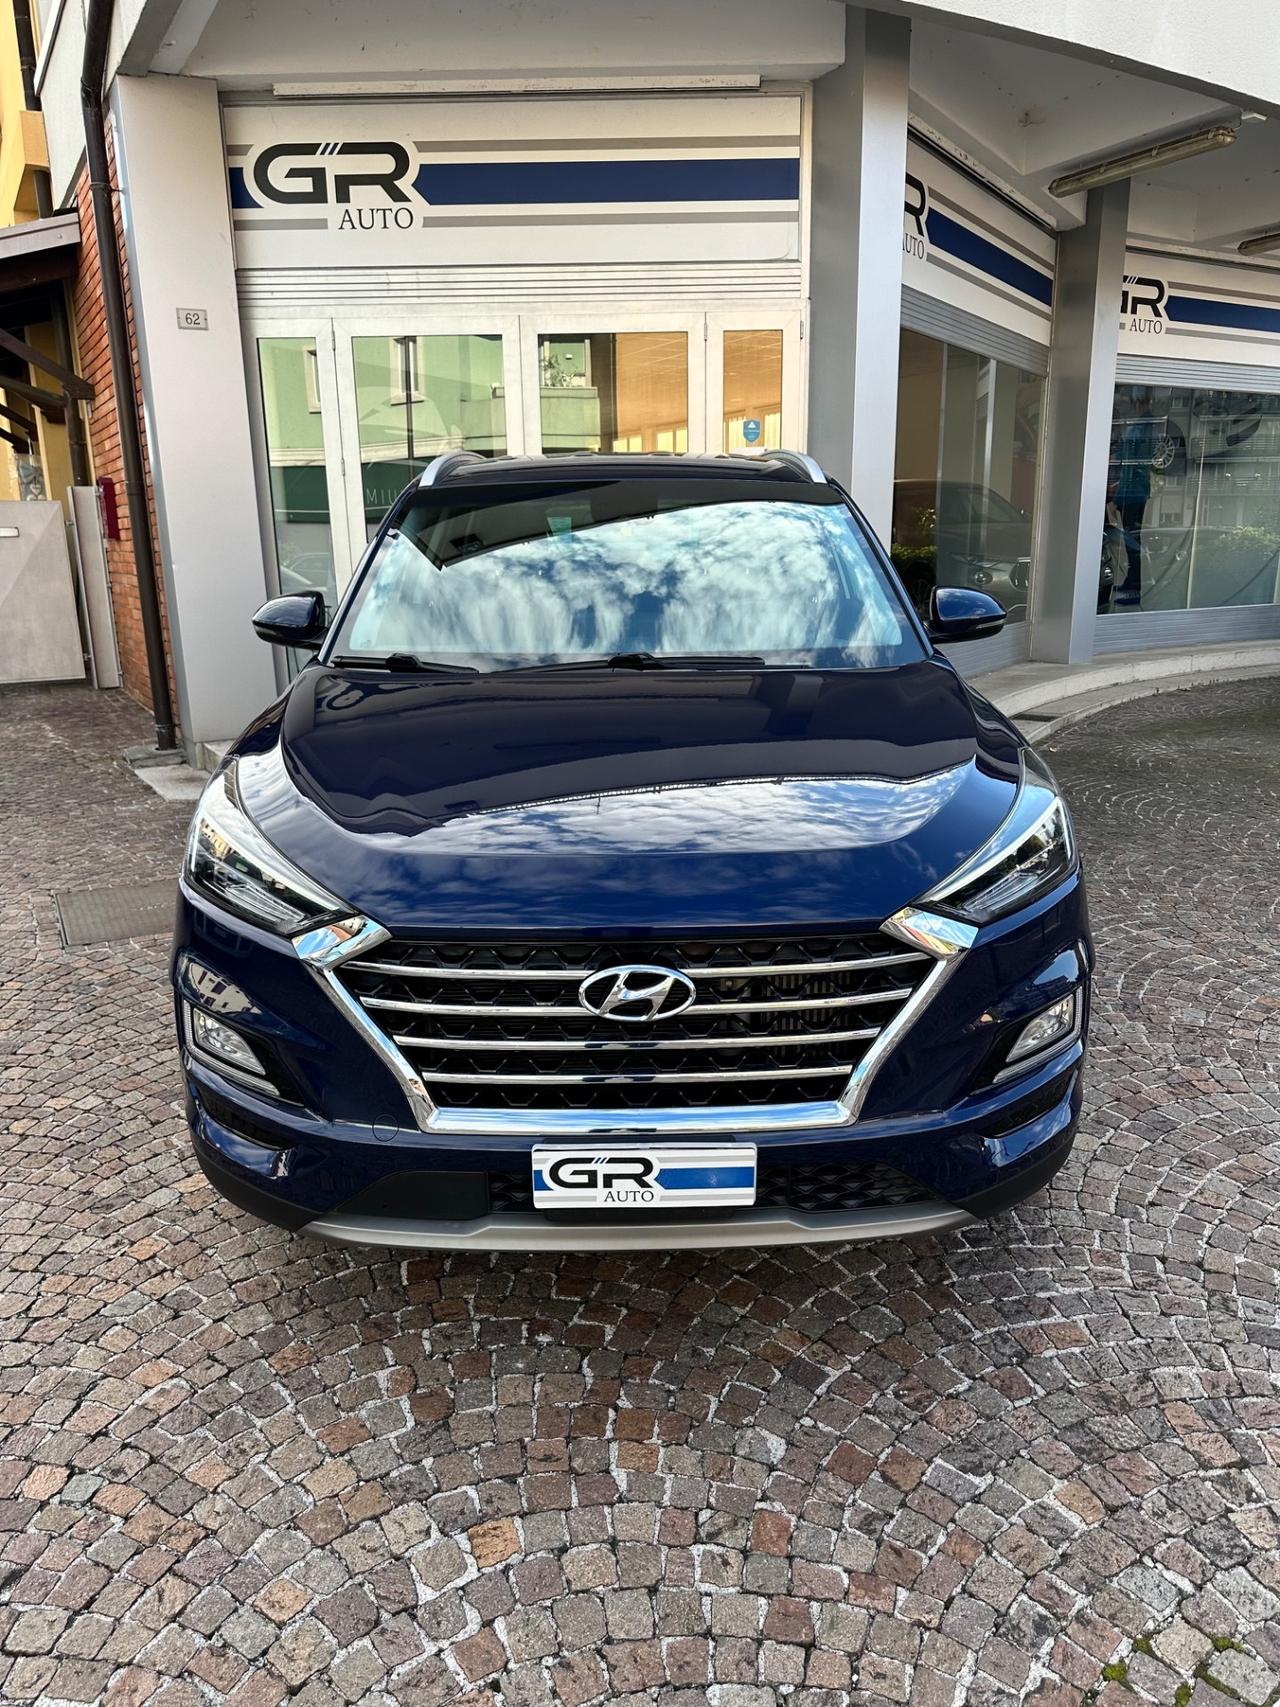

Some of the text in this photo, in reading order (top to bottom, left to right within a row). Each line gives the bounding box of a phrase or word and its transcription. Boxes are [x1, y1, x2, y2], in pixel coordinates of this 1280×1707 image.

[253, 141, 412, 204] GR
[338, 207, 414, 230] AUTO
[902, 232, 925, 260] UTO
[185, 312, 201, 325] 62
[1129, 317, 1163, 335] AUTO
[549, 1157, 654, 1189] GR
[604, 1190, 654, 1203] AUTO
